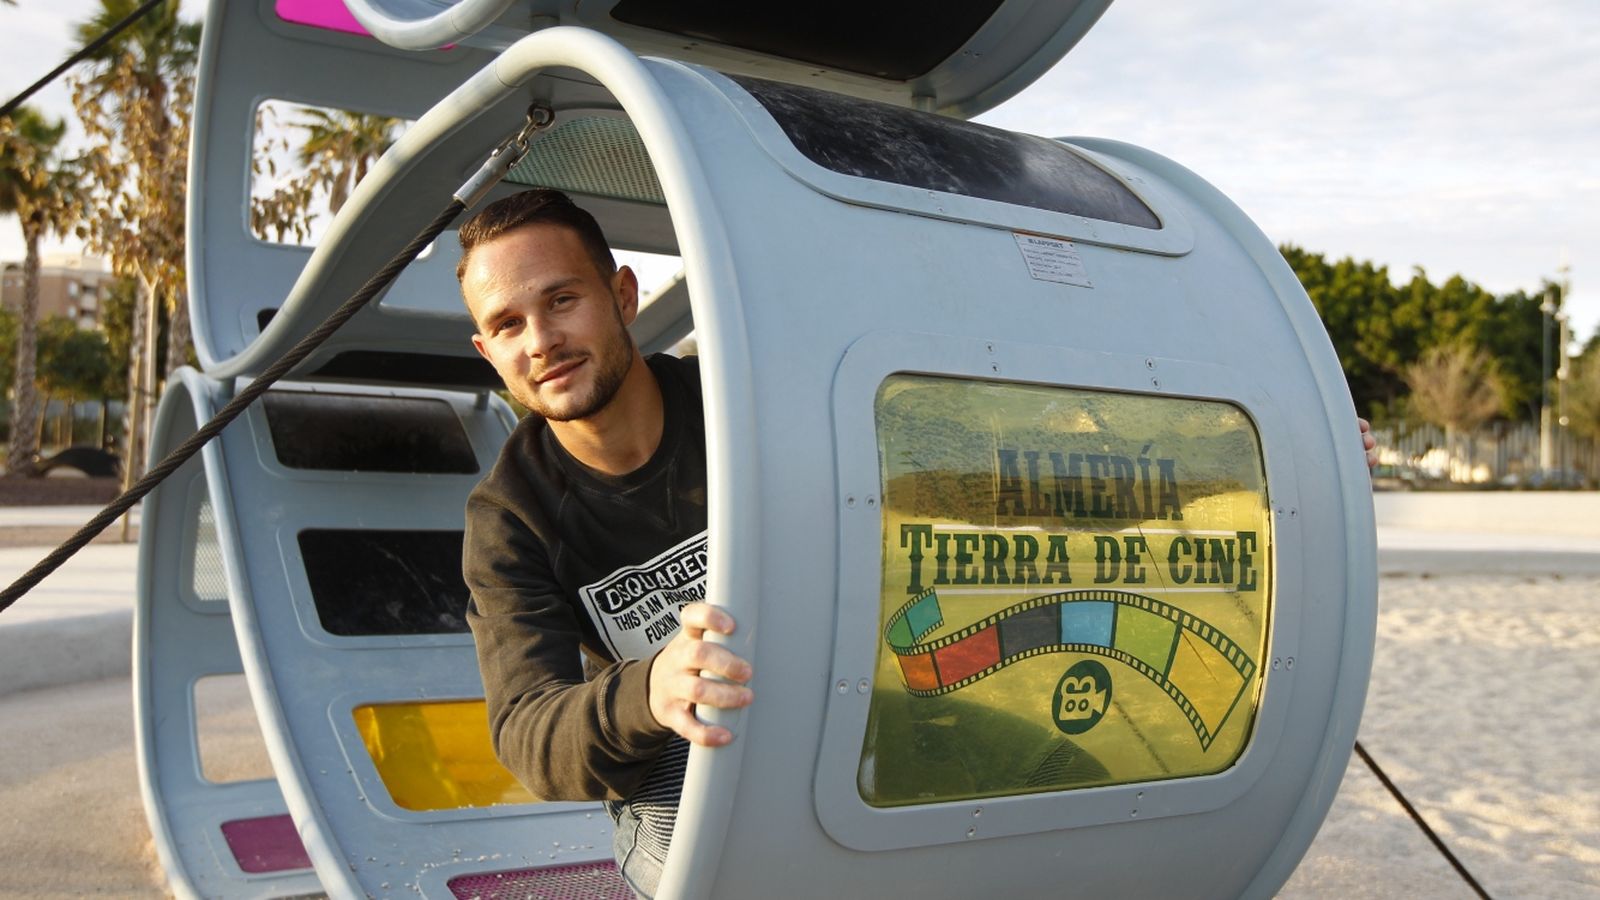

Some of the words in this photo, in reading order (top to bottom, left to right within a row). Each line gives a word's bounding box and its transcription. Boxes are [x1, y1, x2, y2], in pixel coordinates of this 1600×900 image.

[997, 444, 1184, 521] ALMERÍA
[900, 524, 1072, 595] TIERRA
[1093, 535, 1146, 584] DE
[1167, 531, 1257, 592] CINE
[612, 609, 641, 631] THIS
[636, 605, 651, 622] IS
[645, 594, 664, 616] AN
[661, 579, 707, 606] HONORA
[644, 611, 681, 645] FUCKIN
